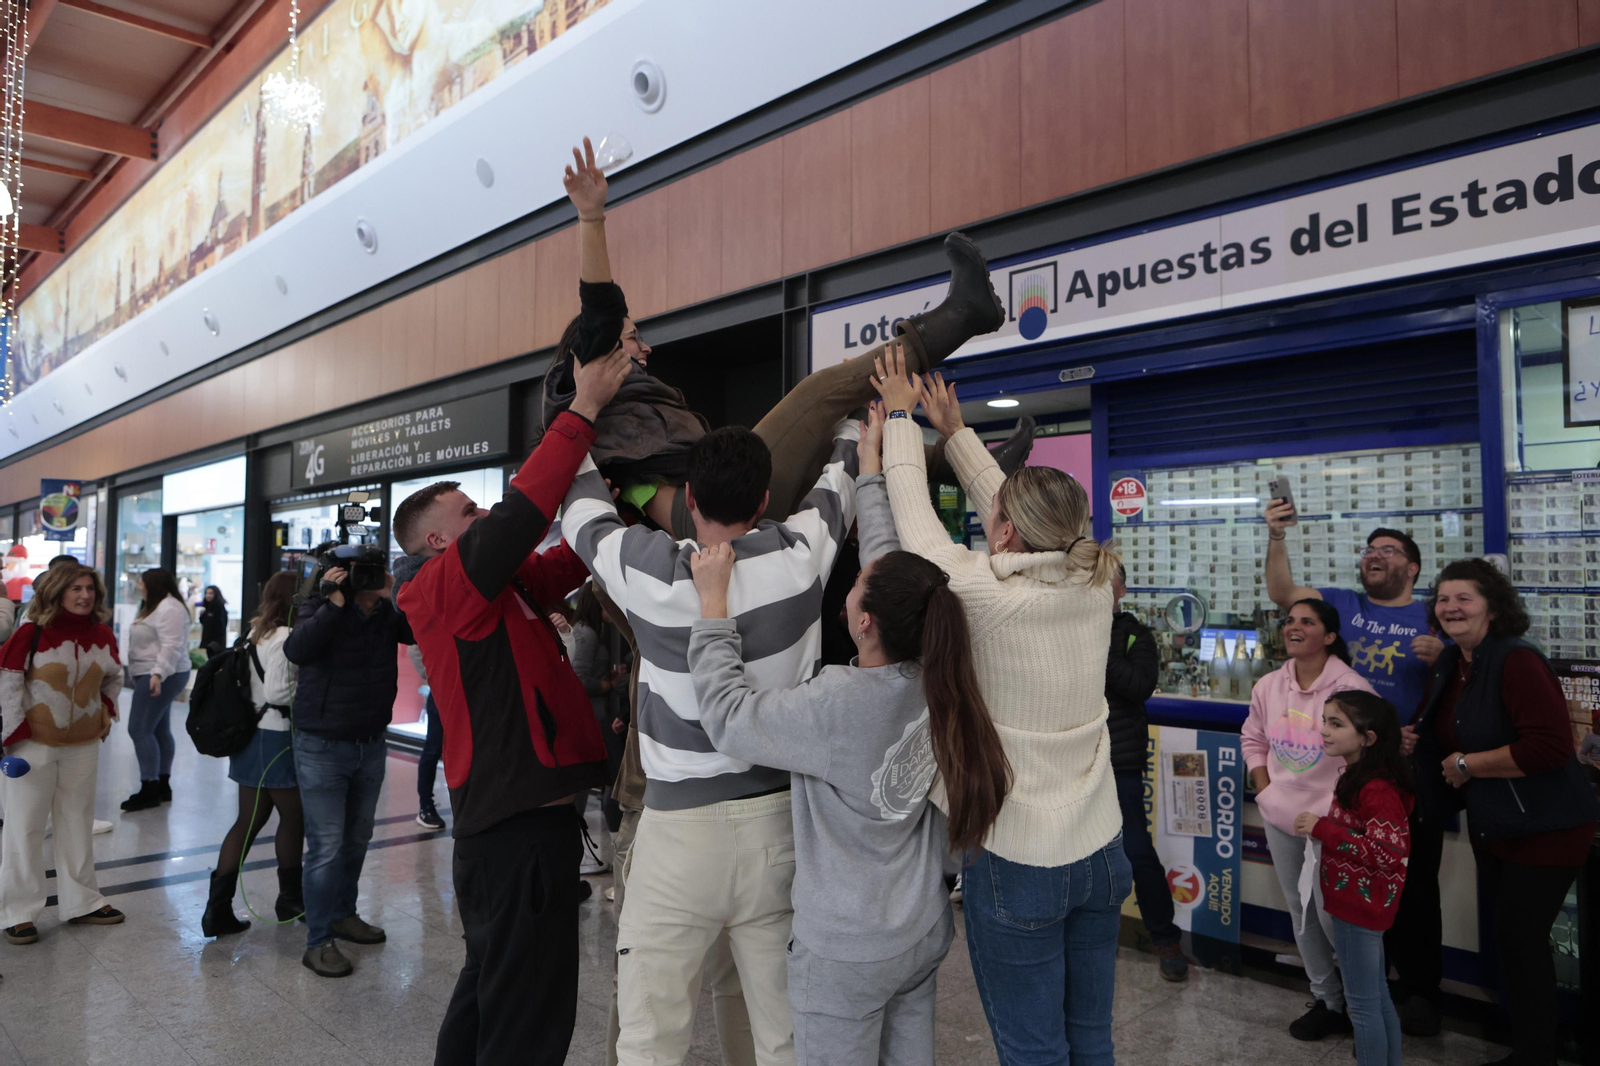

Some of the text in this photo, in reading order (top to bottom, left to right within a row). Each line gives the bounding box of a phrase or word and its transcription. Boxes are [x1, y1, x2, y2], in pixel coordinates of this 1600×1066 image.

[1065, 236, 1272, 308] Apuestas
[1290, 202, 1369, 256] del
[351, 406, 443, 437] ACCESORIOS PARA
[351, 418, 451, 449] MÓVILES Y TABLETS
[305, 444, 325, 485] 4G
[351, 441, 421, 464] LIBERACIÓN Y
[351, 441, 489, 476] REPARACIÓN DE MÓVILES
[1351, 613, 1417, 637] On The Move
[1196, 780, 1207, 820] 88008
[1216, 746, 1236, 858] EL GORDO
[1220, 868, 1232, 926] VENDIDO
